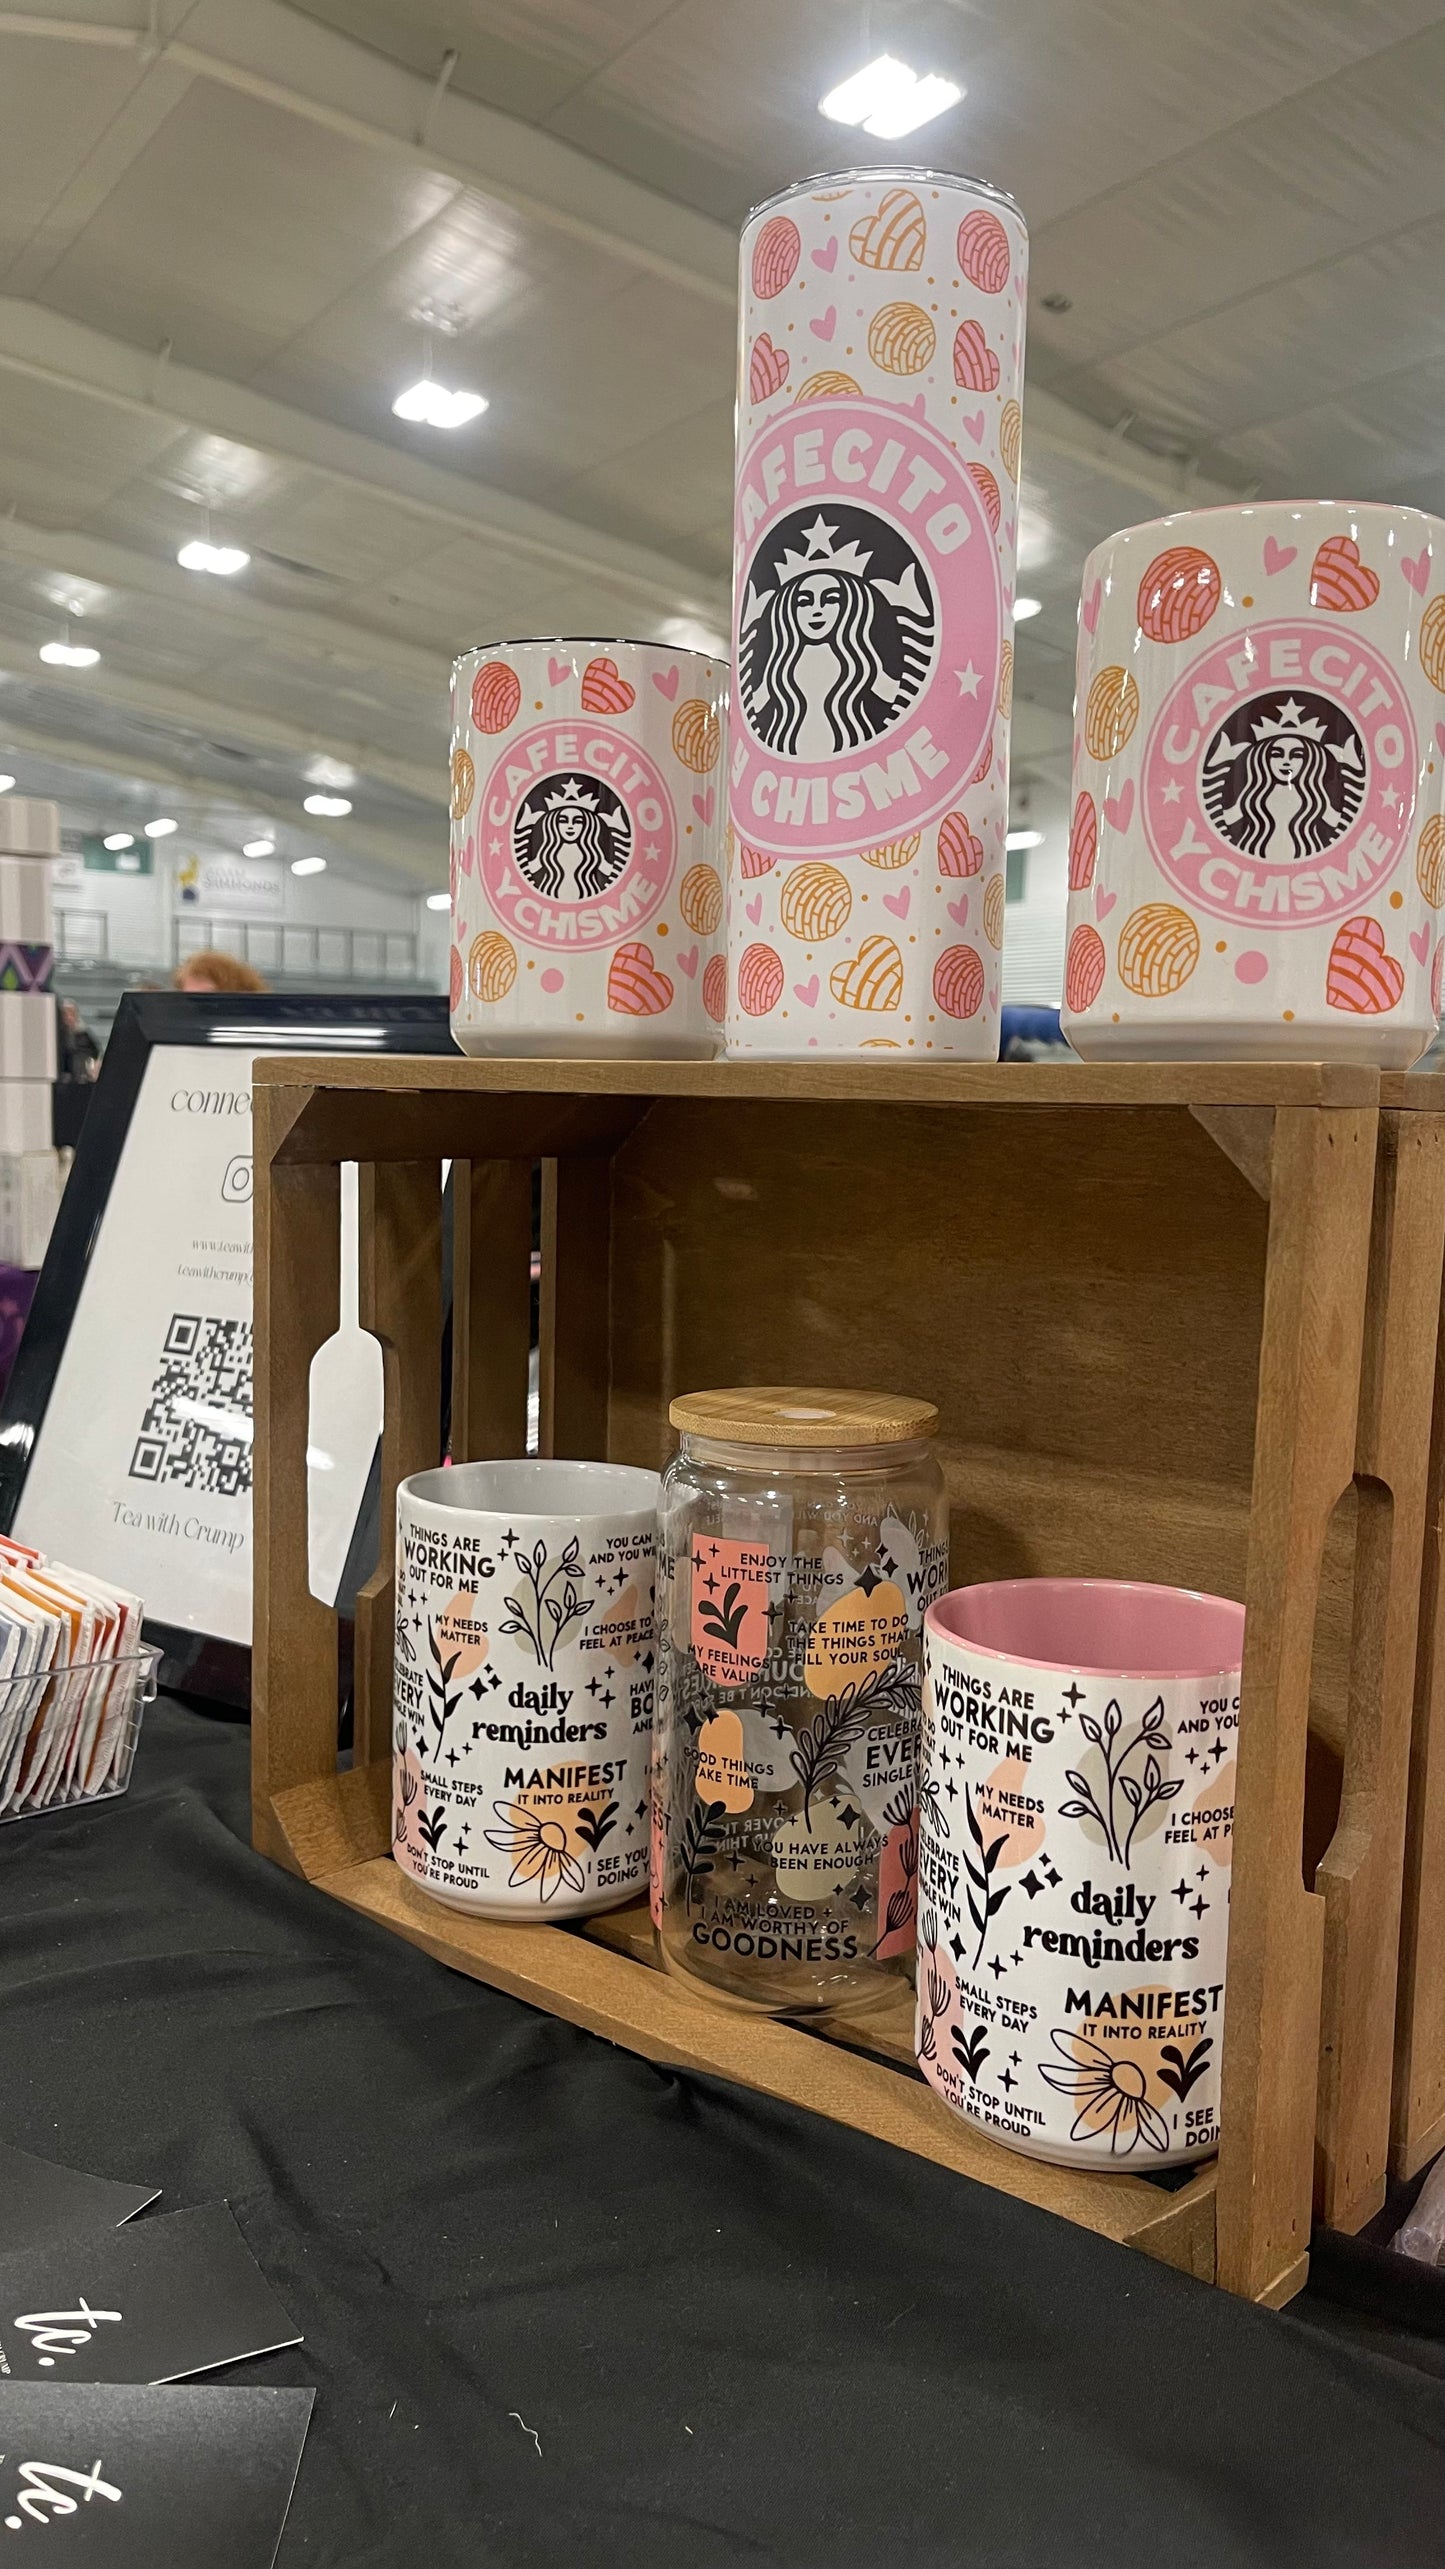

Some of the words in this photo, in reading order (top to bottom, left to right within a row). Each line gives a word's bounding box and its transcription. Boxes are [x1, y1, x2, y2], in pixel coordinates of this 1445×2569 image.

[1162, 639, 1406, 768] CAFECITO
[489, 734, 664, 827] CAFECITO
[751, 725, 950, 826] CHISME
[1169, 819, 1212, 861] Y
[1200, 829, 1394, 912] CHISME
[495, 866, 523, 898] Y
[514, 870, 657, 941] CHISME
[171, 1089, 252, 1115] conne
[113, 1501, 142, 1528] Tea
[147, 1513, 180, 1535] with
[184, 1517, 244, 1554] Crump
[410, 1524, 448, 1548] THINGS
[453, 1537, 480, 1552] ARE
[607, 1536, 628, 1549] YOU
[632, 1533, 652, 1545] CAN
[405, 1538, 495, 1578] WORKING
[589, 1551, 614, 1564] AND
[618, 1549, 640, 1563] YOU
[740, 1553, 788, 1568] ENJOY
[794, 1558, 822, 1569] THE
[409, 1564, 426, 1586] OUT
[430, 1572, 453, 1590] FOR
[459, 1579, 479, 1594] ME
[721, 1566, 780, 1584] LITTLEST
[787, 1573, 844, 1585] THINGS
[435, 1614, 450, 1626] MY
[453, 1617, 488, 1633] NEEDS
[585, 1626, 588, 1636] I
[592, 1619, 636, 1636] CHOOSE
[634, 1616, 651, 1628] TO
[790, 1621, 827, 1634] TAKE
[832, 1620, 865, 1634] TIME
[870, 1618, 888, 1631] TO
[892, 1614, 909, 1627] DO
[441, 1629, 480, 1646] MATTER
[580, 1638, 605, 1650] FEEL
[609, 1635, 624, 1646] AT
[626, 1629, 654, 1643] PEACE
[787, 1637, 816, 1650] THE
[822, 1633, 876, 1649] THINGS
[880, 1630, 909, 1644] THAT
[688, 1644, 703, 1658] MY
[708, 1649, 770, 1669] FEELINGS
[794, 1653, 822, 1665] FILL
[828, 1650, 868, 1665] YOUR
[872, 1646, 903, 1661] SOUL
[695, 1661, 716, 1676] ARE
[722, 1667, 760, 1683] VALID
[508, 1682, 574, 1716] daily
[942, 1664, 991, 1699] THINGS
[998, 1687, 1035, 1710] ARE
[408, 1708, 425, 1727] WIN
[934, 1679, 1055, 1744] WORKING
[1200, 1698, 1227, 1714] YOU
[472, 1717, 607, 1750] reminders
[941, 1715, 965, 1741] OUT
[969, 1728, 998, 1754] FOR
[1005, 1743, 1032, 1763] ME
[1178, 1719, 1210, 1734] AND
[504, 1759, 627, 1789] MANIFEST
[684, 1746, 716, 1766] GOOD
[722, 1757, 774, 1776] THINGS
[420, 1770, 448, 1788] SMALL
[452, 1780, 483, 1795] STEPS
[695, 1765, 722, 1783] TAKE
[727, 1774, 759, 1789] TIME
[862, 1768, 912, 1788] SINGLE
[424, 1785, 451, 1802] EVERY
[456, 1794, 477, 1807] DAY
[518, 1794, 529, 1805] IT
[533, 1794, 563, 1805] INTO
[568, 1788, 615, 1804] REALITY
[975, 1782, 994, 1800] MY
[998, 1790, 1045, 1813] NEEDS
[982, 1802, 1035, 1829] MATTER
[1171, 1813, 1175, 1826] I
[754, 1841, 783, 1854] YOU
[789, 1842, 828, 1855] HAVE
[835, 1835, 889, 1853] ALWAYS
[1165, 1830, 1197, 1844] FEEL
[1203, 1826, 1219, 1840] AT
[407, 1843, 429, 1866] DON'T
[431, 1854, 455, 1871] STOP
[458, 1863, 490, 1879] UNTIL
[587, 1861, 591, 1873] I
[597, 1855, 620, 1872] SEE
[625, 1847, 648, 1863] YOU
[771, 1856, 808, 1870] BEEN
[814, 1854, 874, 1870] ENOUGH
[413, 1859, 441, 1881] YOU'RE
[443, 1872, 479, 1890] PROUD
[597, 1865, 639, 1887] DOING
[724, 1897, 749, 1916] AM
[757, 1902, 815, 1919] LOVED
[940, 1896, 961, 1923] WIN
[1070, 1881, 1157, 1926] daily
[711, 1909, 733, 1925] AM
[743, 1916, 818, 1935] WORTHY
[827, 1921, 849, 1934] OF
[692, 1922, 858, 1962] GOODNESS
[1023, 1925, 1199, 1968] reminders
[955, 1976, 991, 2005] SMALL
[996, 1996, 1038, 2020] STEPS
[1065, 1984, 1224, 2020] MANIFEST
[960, 1998, 996, 2024] EVERY
[1001, 2013, 1029, 2034] DAY
[1083, 2023, 1098, 2037] IT
[1103, 2026, 1142, 2040] INTO
[1148, 2021, 1207, 2040] REALITY
[936, 2062, 965, 2093] DON'T
[968, 2085, 1000, 2111] STOP
[1005, 2100, 1046, 2126] UNTIL
[944, 2086, 981, 2120] YOU'RE
[985, 2111, 1031, 2138] PROUD
[1173, 2114, 1177, 2130] I
[1185, 2107, 1214, 2128] SEE
